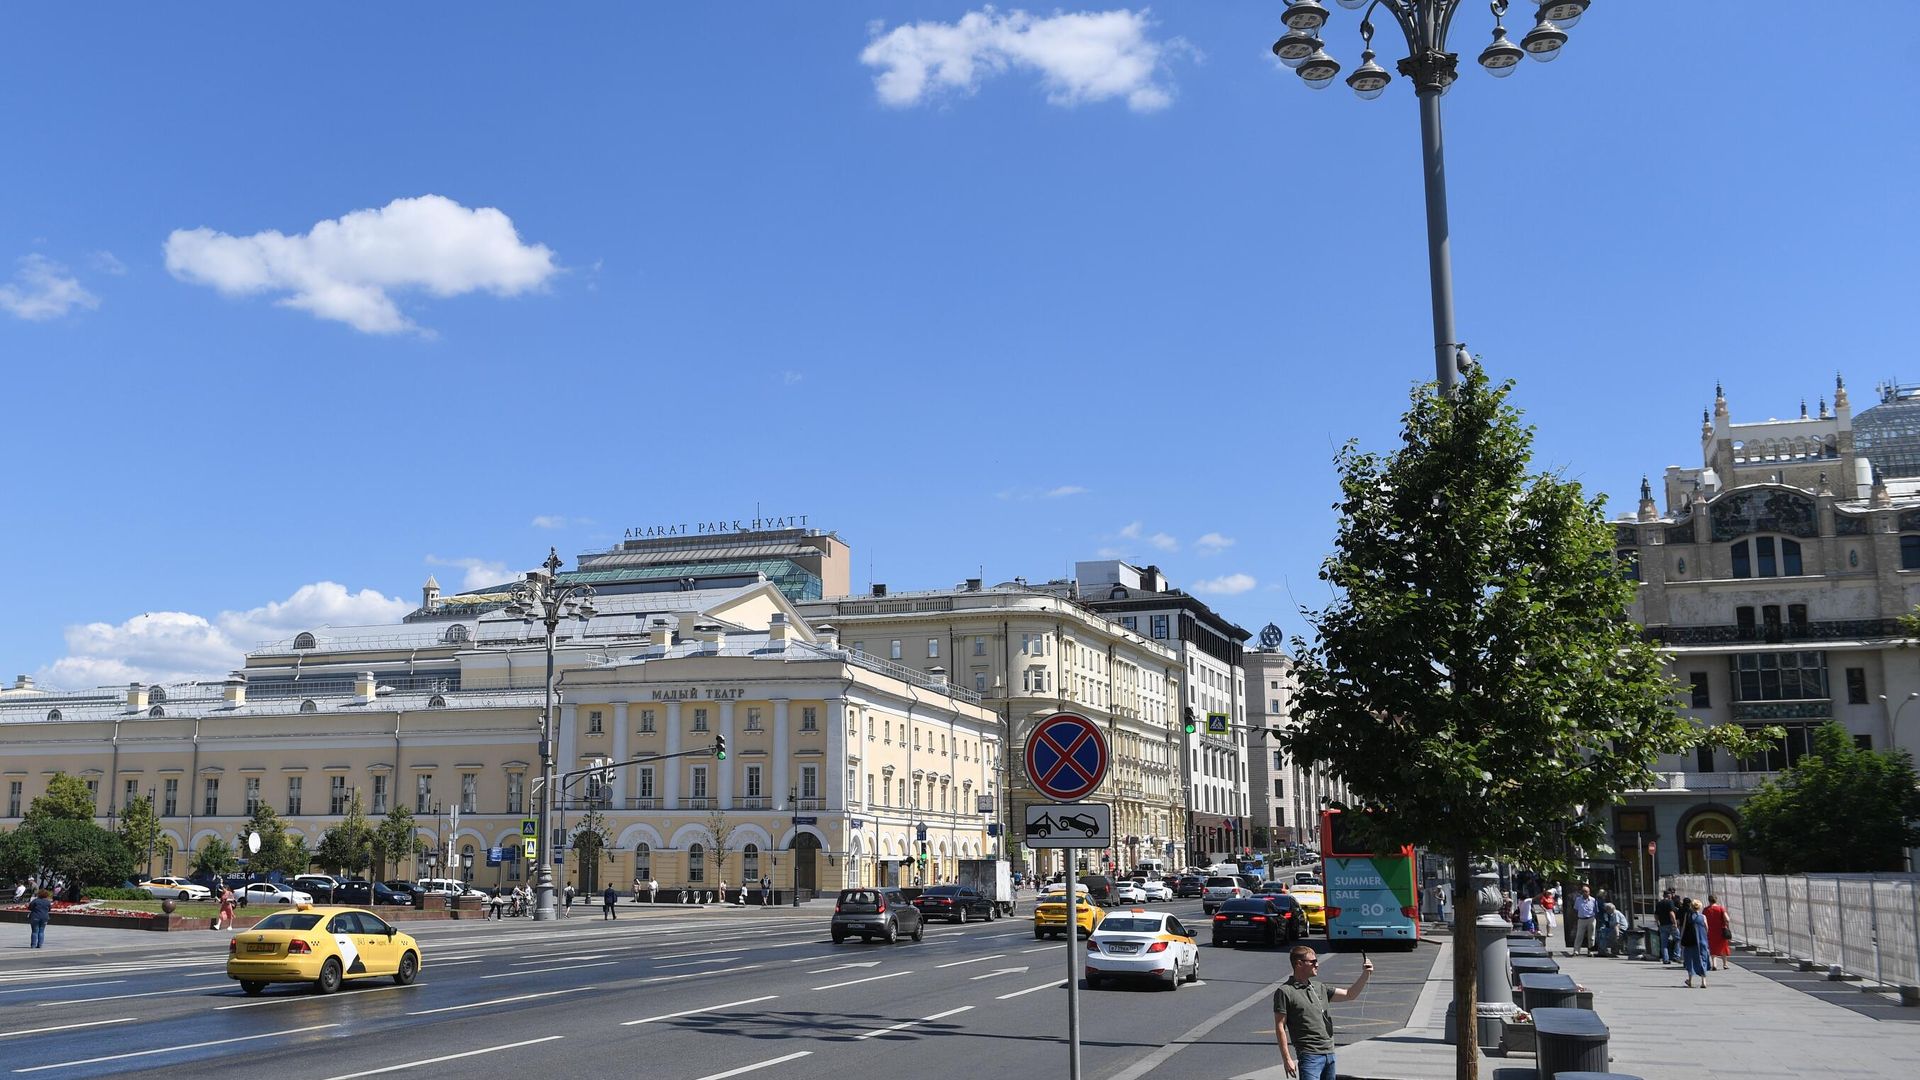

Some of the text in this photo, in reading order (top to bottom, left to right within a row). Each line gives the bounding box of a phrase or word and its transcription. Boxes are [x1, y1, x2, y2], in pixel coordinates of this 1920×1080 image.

[624, 515, 808, 538] ARARAT PARK HYATT
[652, 688, 745, 700] МАЛЫЙ ТЕАТР
[1689, 830, 1732, 841] Mercury
[1335, 876, 1382, 886] SUMMER
[1335, 890, 1360, 900] SALE
